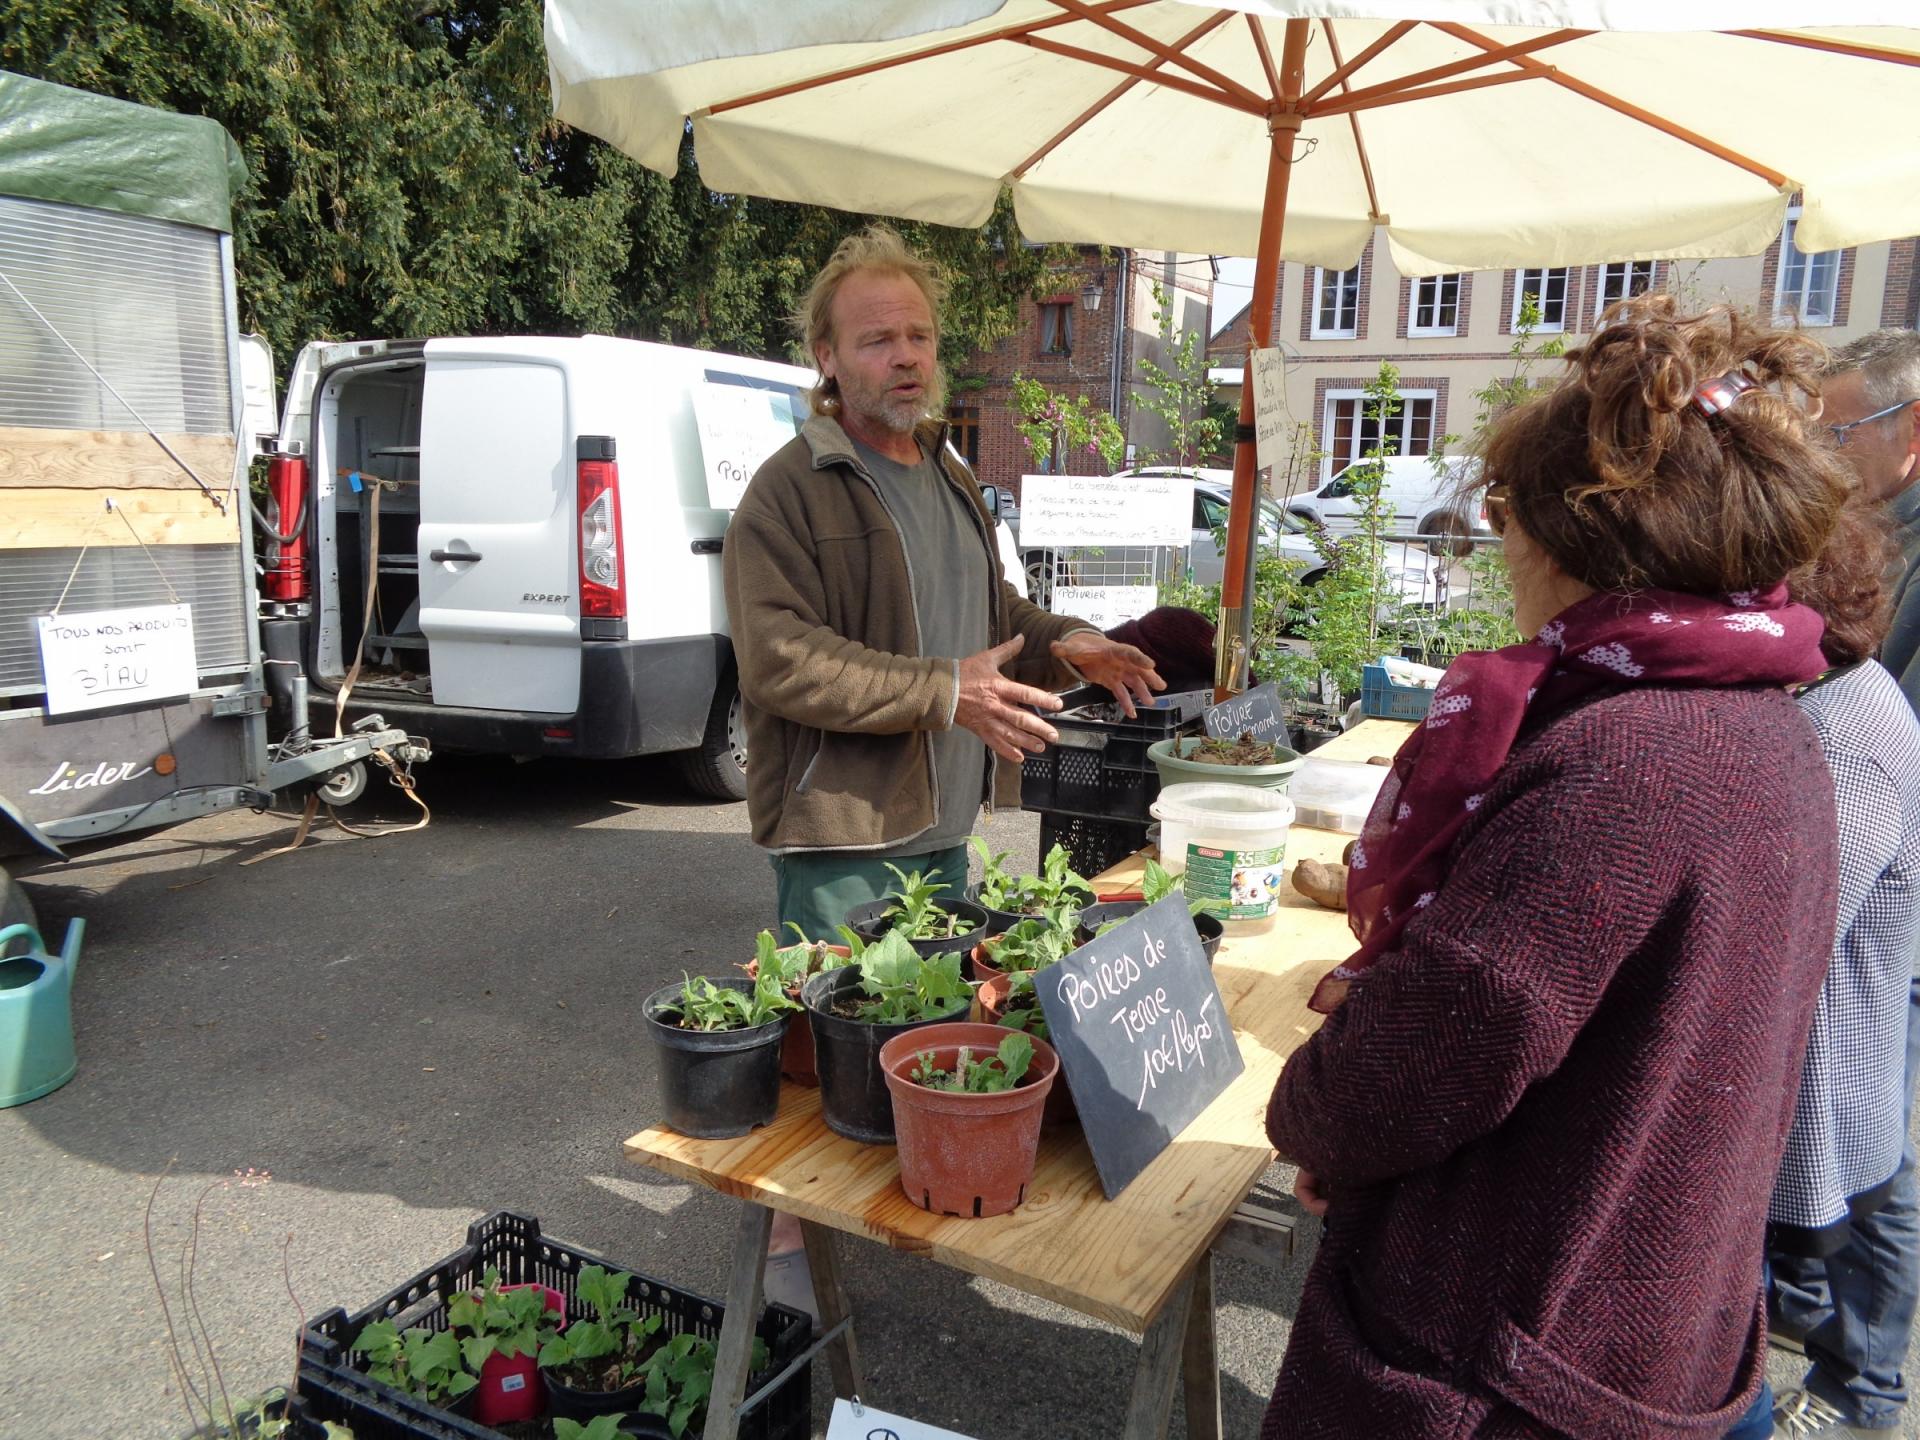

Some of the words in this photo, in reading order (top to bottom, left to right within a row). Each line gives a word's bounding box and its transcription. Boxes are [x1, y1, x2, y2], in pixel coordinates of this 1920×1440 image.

[523, 593, 570, 603] EXPERT
[48, 627, 90, 639] TOUS
[97, 625, 123, 636] NOS
[28, 761, 153, 795] Lider
[1143, 929, 1167, 968] de
